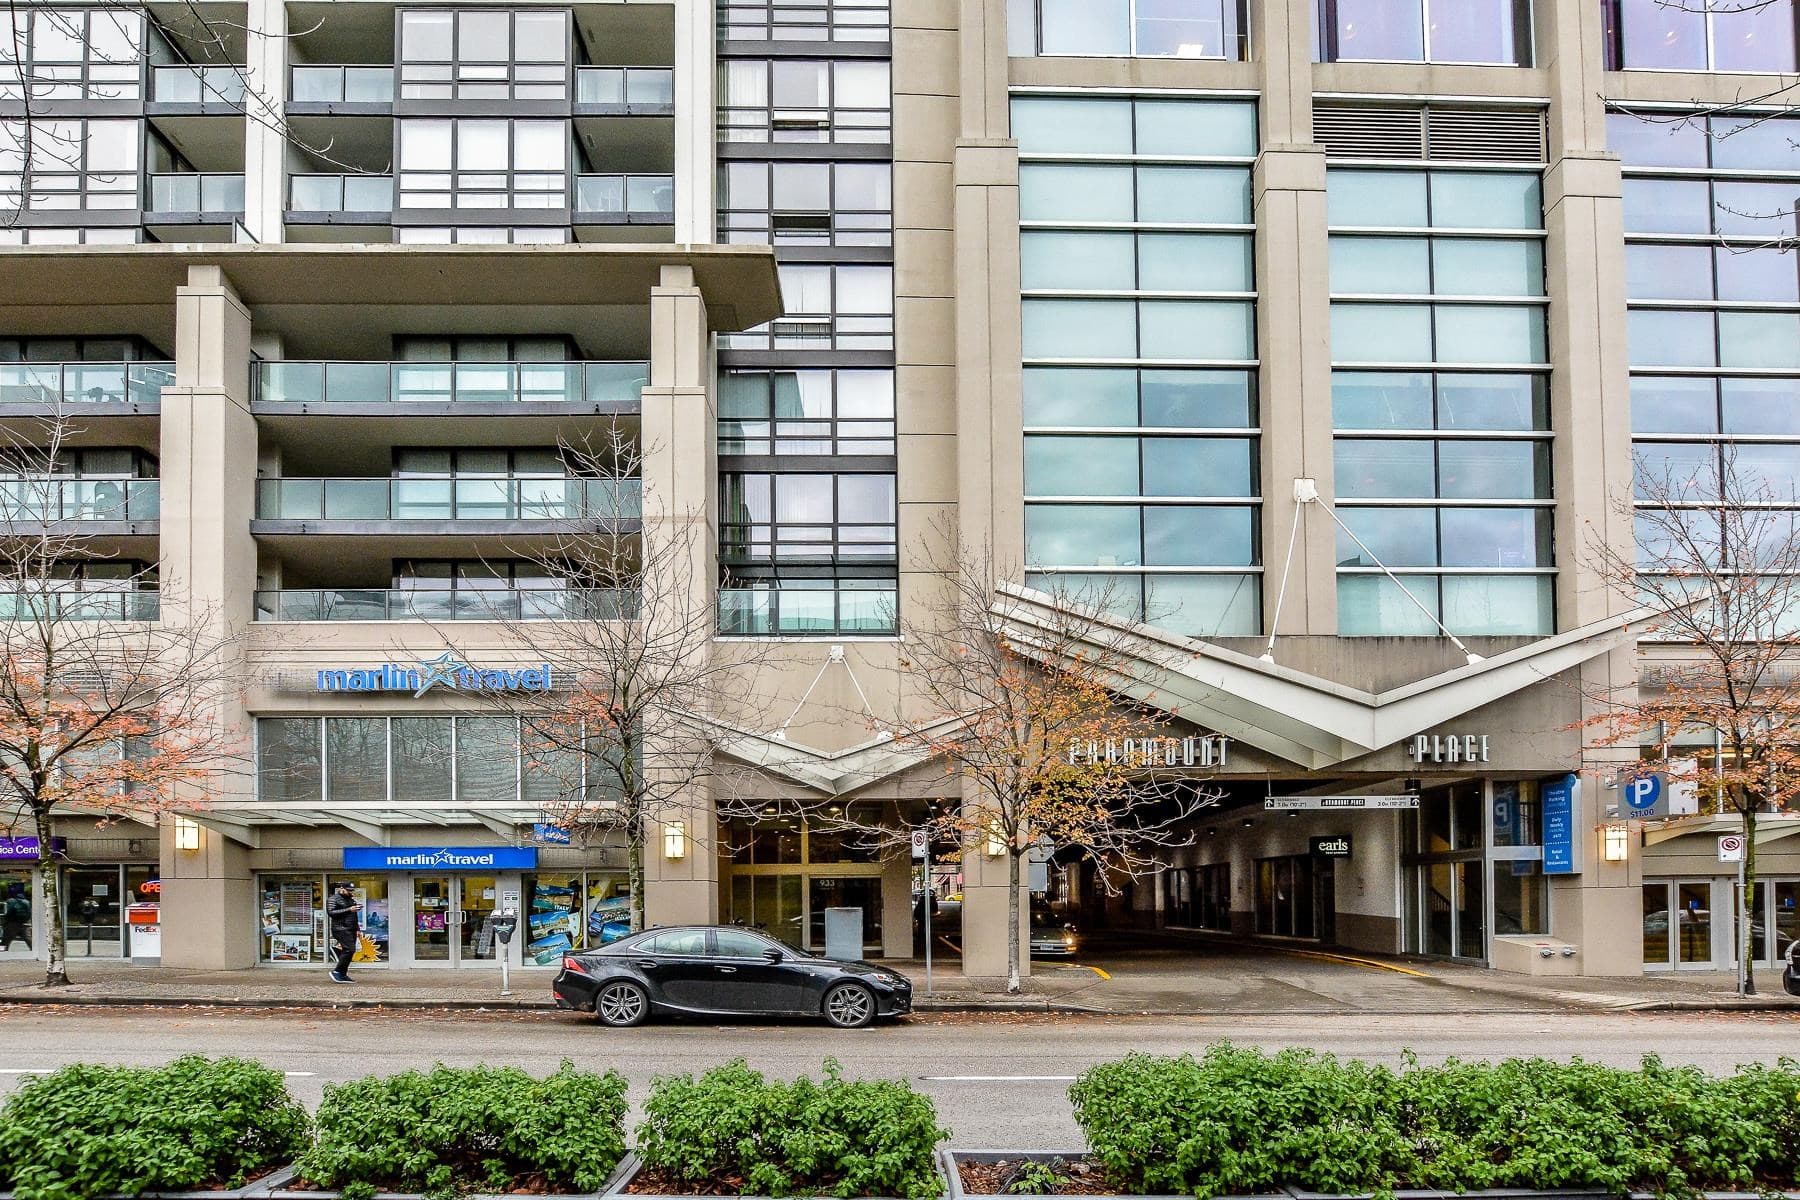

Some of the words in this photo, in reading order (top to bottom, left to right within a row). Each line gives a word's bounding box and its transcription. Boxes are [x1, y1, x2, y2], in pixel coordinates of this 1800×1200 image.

[317, 664, 419, 690] marlin
[457, 664, 550, 690] travel
[1069, 737, 1229, 766] PARAMOUNT
[1414, 734, 1490, 762] PLACE
[1634, 777, 1653, 804] P
[1630, 808, 1655, 818] $11.00
[1319, 839, 1348, 851] earls
[386, 853, 435, 866] marlin
[449, 853, 494, 866] travel
[140, 882, 161, 893] OPE
[554, 904, 570, 912] ITALY
